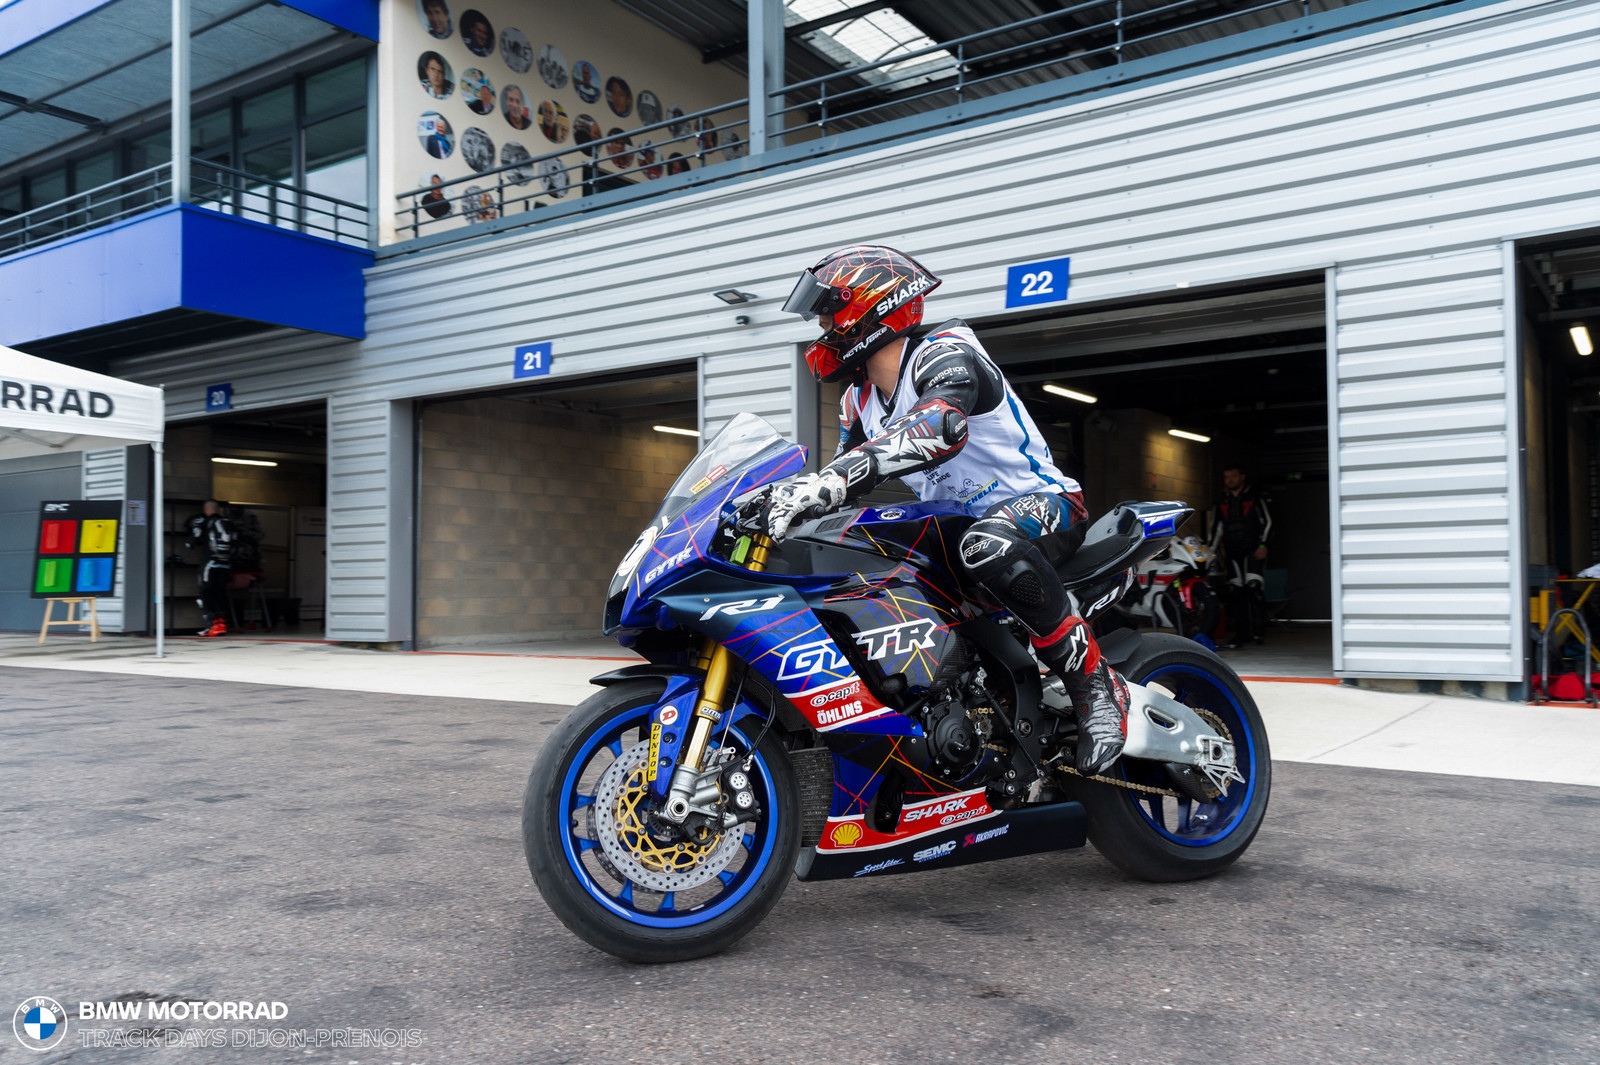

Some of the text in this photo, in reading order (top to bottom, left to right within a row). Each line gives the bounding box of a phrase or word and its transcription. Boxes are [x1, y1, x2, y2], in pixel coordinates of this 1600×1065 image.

[876, 275, 929, 316] SHARK
[1021, 270, 1054, 297] 22
[523, 351, 542, 370] 21
[211, 390, 226, 406] 20
[926, 471, 940, 481] LIFE
[935, 472, 952, 484] RIDE
[645, 546, 694, 584] GYTR
[700, 596, 785, 621] R1
[662, 710, 676, 722] D
[816, 700, 863, 725] ÖHLINS
[649, 724, 662, 778] DUNLOP
[903, 797, 971, 822] SHARK
[913, 840, 957, 862] SEMC
